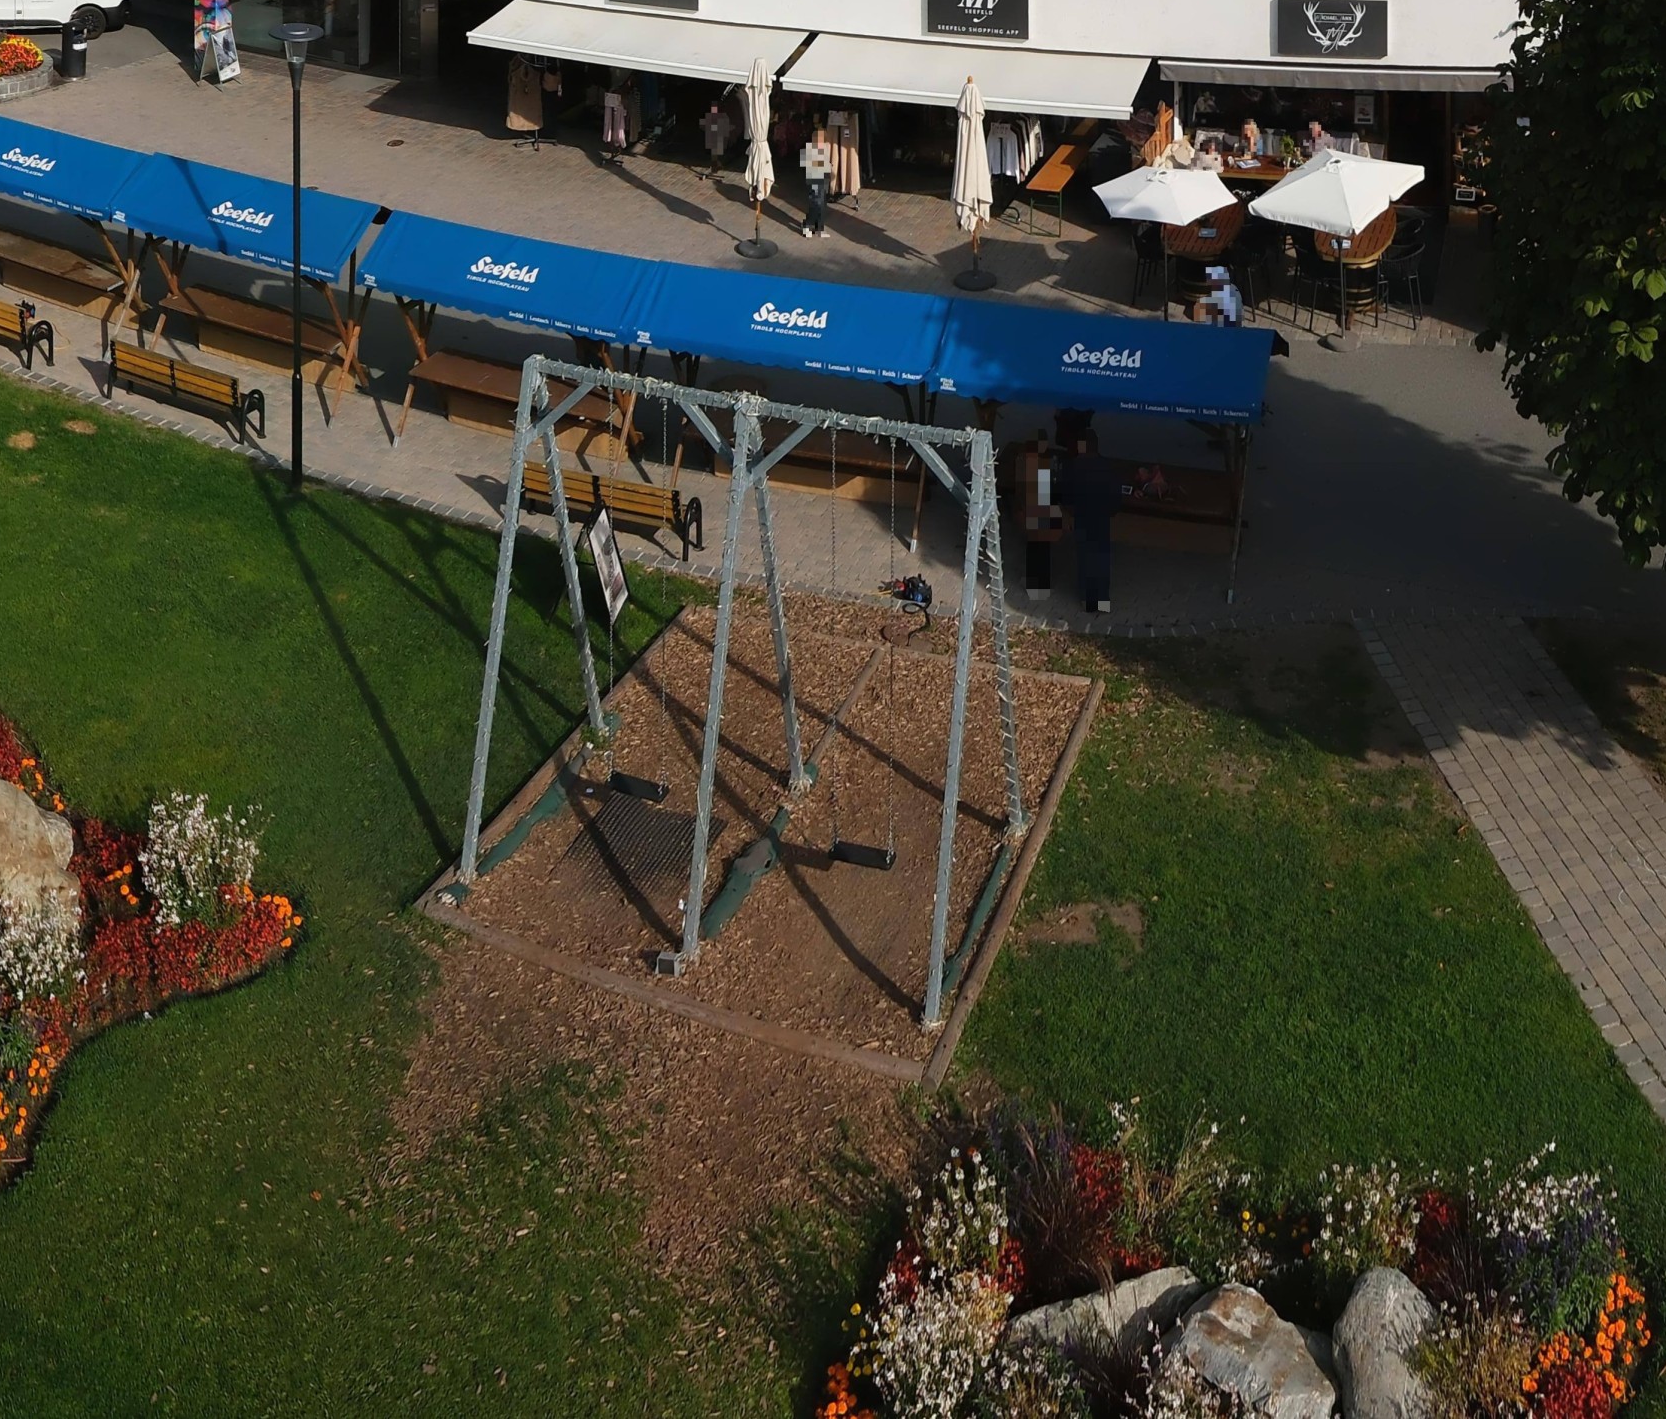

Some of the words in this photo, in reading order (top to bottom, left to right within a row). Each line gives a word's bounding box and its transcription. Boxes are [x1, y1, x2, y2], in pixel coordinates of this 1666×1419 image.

[938, 24, 966, 32] SEEFELD
[969, 26, 1004, 35] SHOPPING
[1, 147, 56, 172] Seefeld
[212, 201, 274, 228] Seefeld
[471, 256, 541, 284] Seefeld
[753, 302, 828, 330] Seefeld
[1062, 342, 1141, 368] Seefeld
[1060, 366, 1084, 374] TIROLS
[1086, 368, 1137, 379] HOCHPLATEAU
